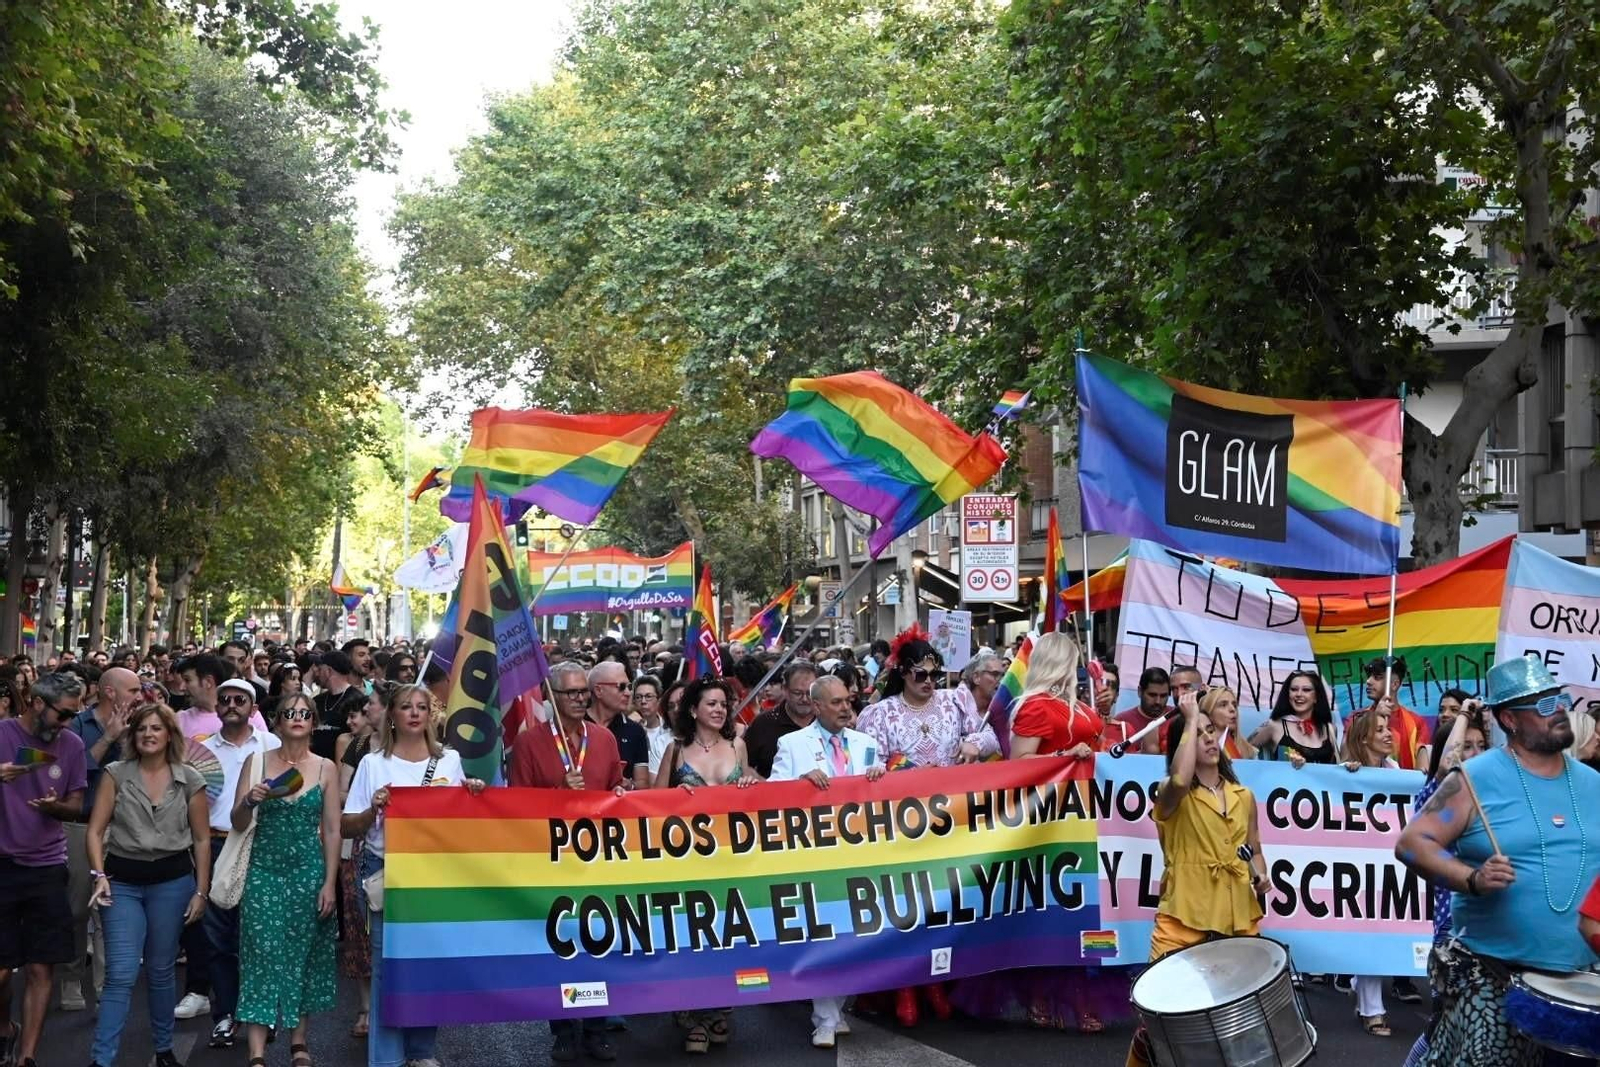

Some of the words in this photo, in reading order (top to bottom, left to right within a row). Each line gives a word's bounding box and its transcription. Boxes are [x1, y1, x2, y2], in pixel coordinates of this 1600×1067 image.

[1179, 430, 1278, 507] GLAM
[543, 563, 645, 591] CCOO
[972, 576, 984, 584] 30
[607, 591, 685, 610] #OrgulloDeSer
[548, 817, 629, 864] POR
[638, 812, 718, 859] LOS
[728, 793, 955, 855] DERECHOS
[1266, 787, 1414, 834] COLECT
[545, 887, 760, 960] CONTRA
[770, 881, 836, 945] EL
[846, 851, 1086, 937] BULLYING
[1099, 851, 1123, 910] Y
[1138, 853, 1161, 910] L
[593, 989, 606, 997] IRIS
